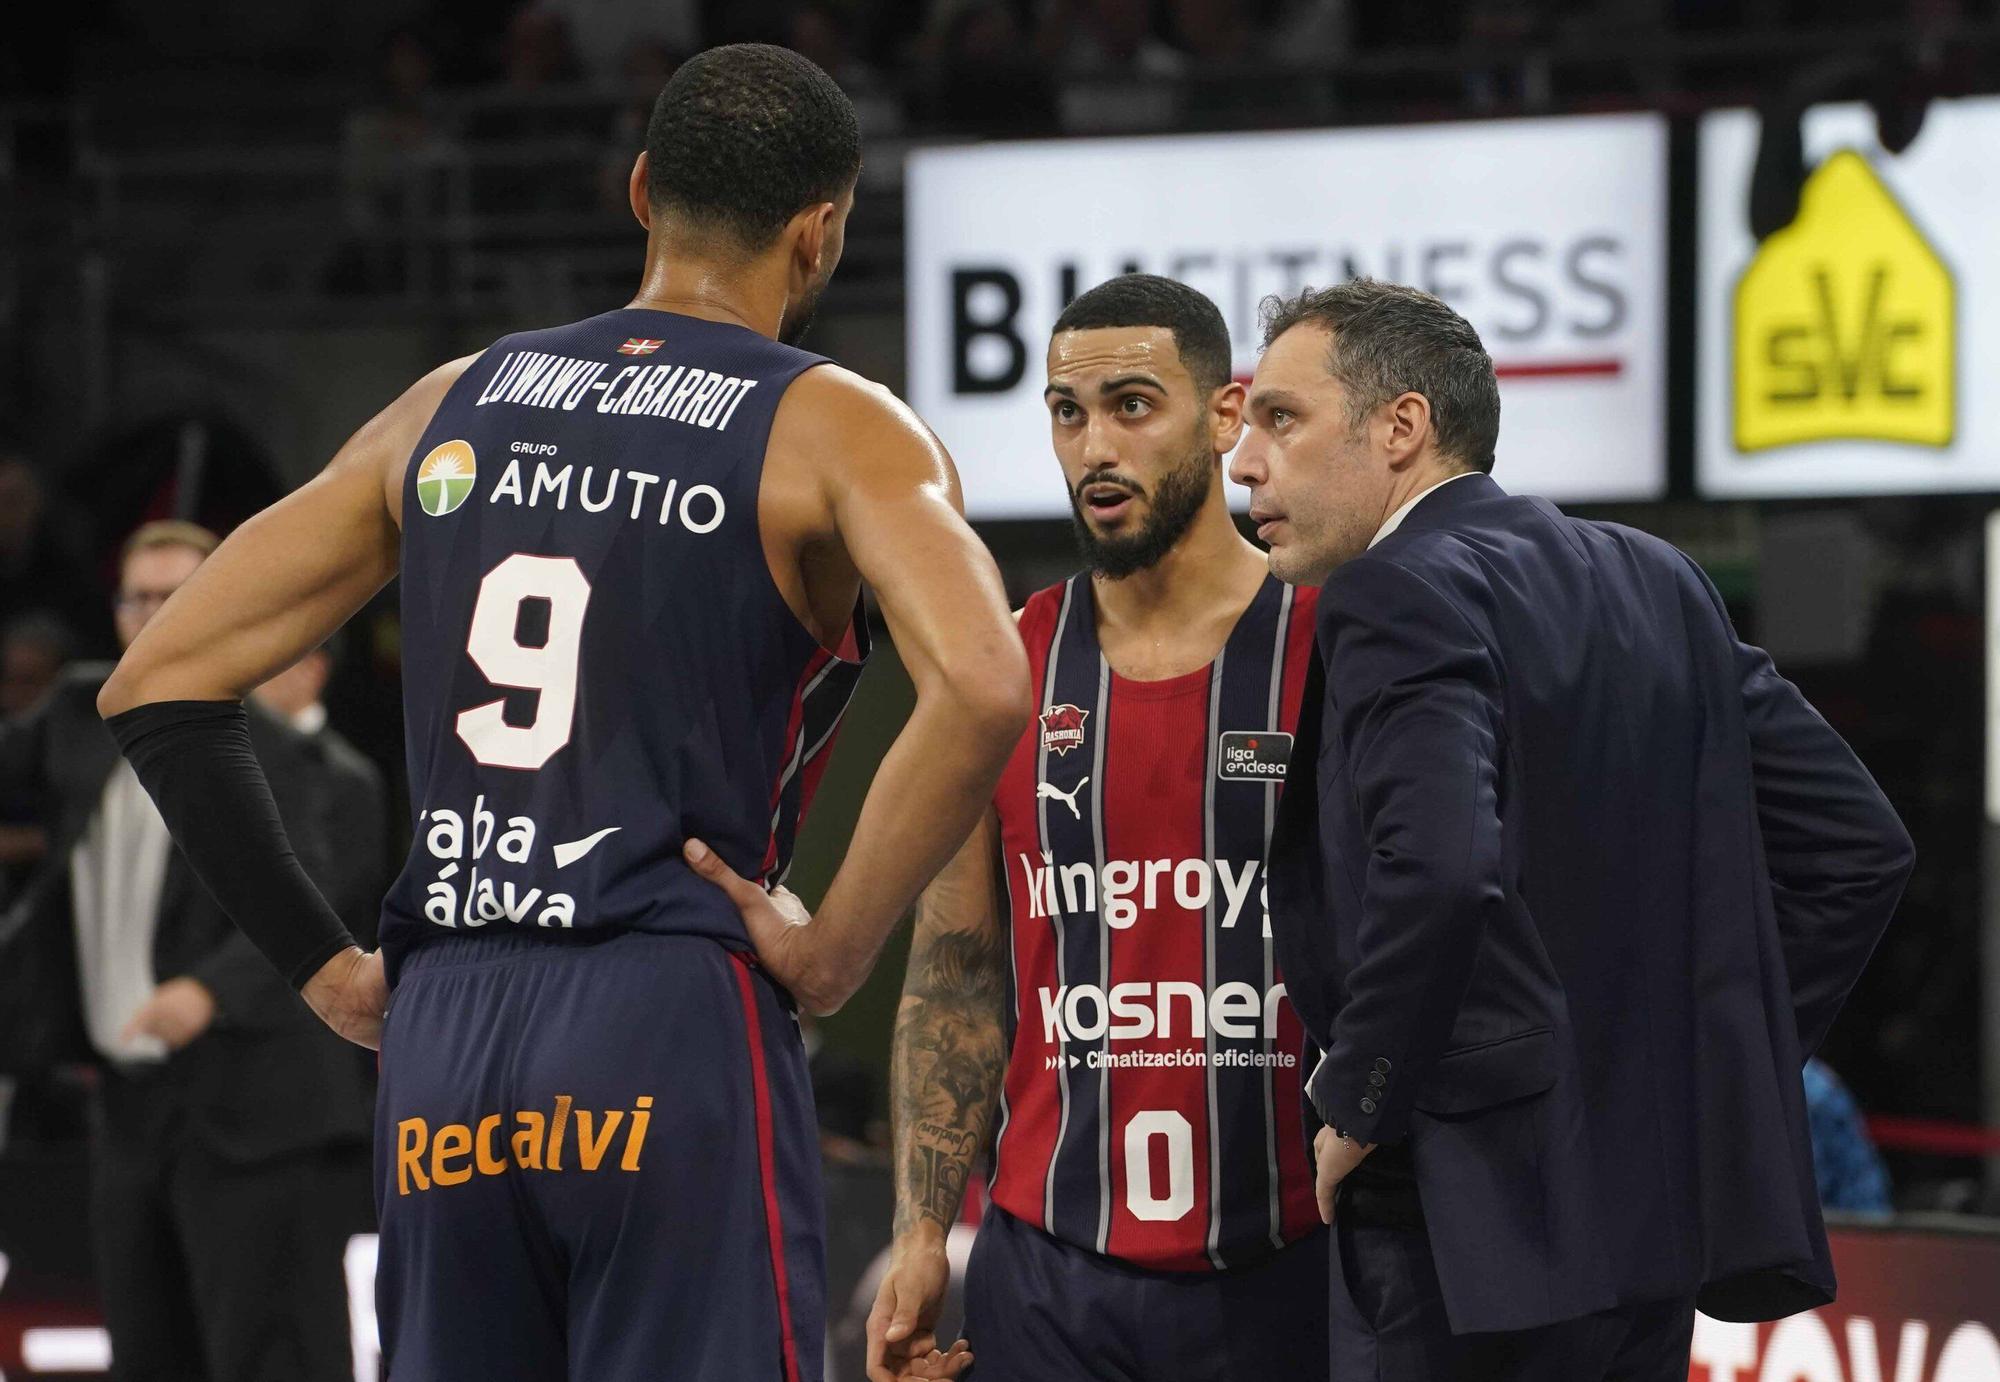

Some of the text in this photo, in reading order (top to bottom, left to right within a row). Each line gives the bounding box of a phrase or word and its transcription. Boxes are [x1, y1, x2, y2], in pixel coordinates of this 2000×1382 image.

[475, 351, 759, 431] LUWAWU-CABARROT
[510, 441, 557, 457] GRUPO
[490, 458, 725, 534] AMUTIO
[455, 551, 592, 772] 9
[1226, 746, 1254, 761] liga
[1226, 760, 1287, 775] endesa
[424, 862, 576, 928] álava
[1019, 850, 1272, 937] kingroy
[1087, 1048, 1296, 1069] Climatización eficiente
[397, 1095, 654, 1196] Recalvi
[1124, 1110, 1195, 1222] 0
